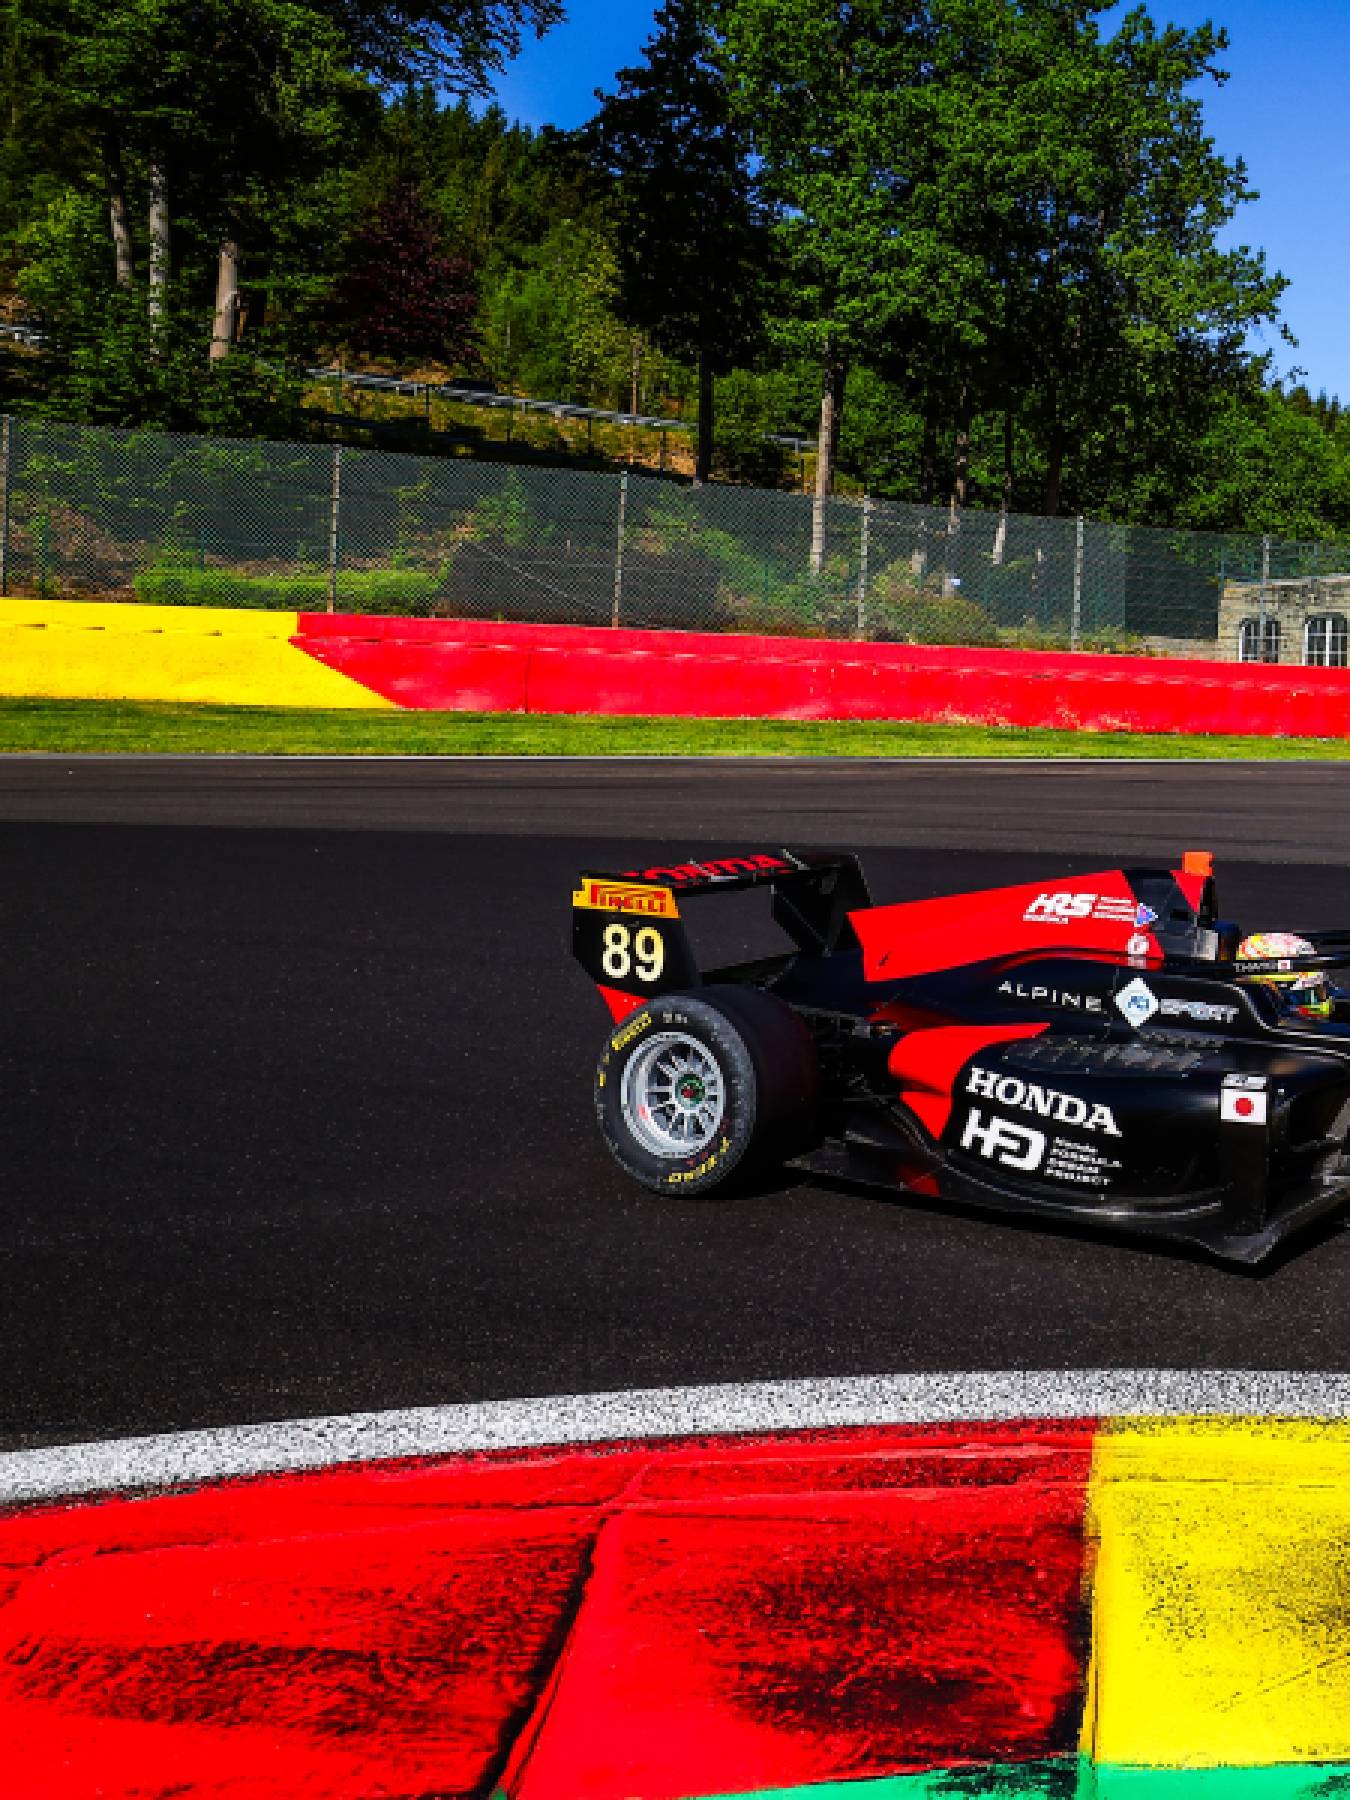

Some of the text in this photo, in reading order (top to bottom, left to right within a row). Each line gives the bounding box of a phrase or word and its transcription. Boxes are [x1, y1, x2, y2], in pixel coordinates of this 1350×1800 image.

[590, 883, 667, 913] PIRELLI
[602, 923, 664, 981] 89
[997, 980, 1103, 1013] ALPINE
[965, 1066, 1123, 1138] HONDA
